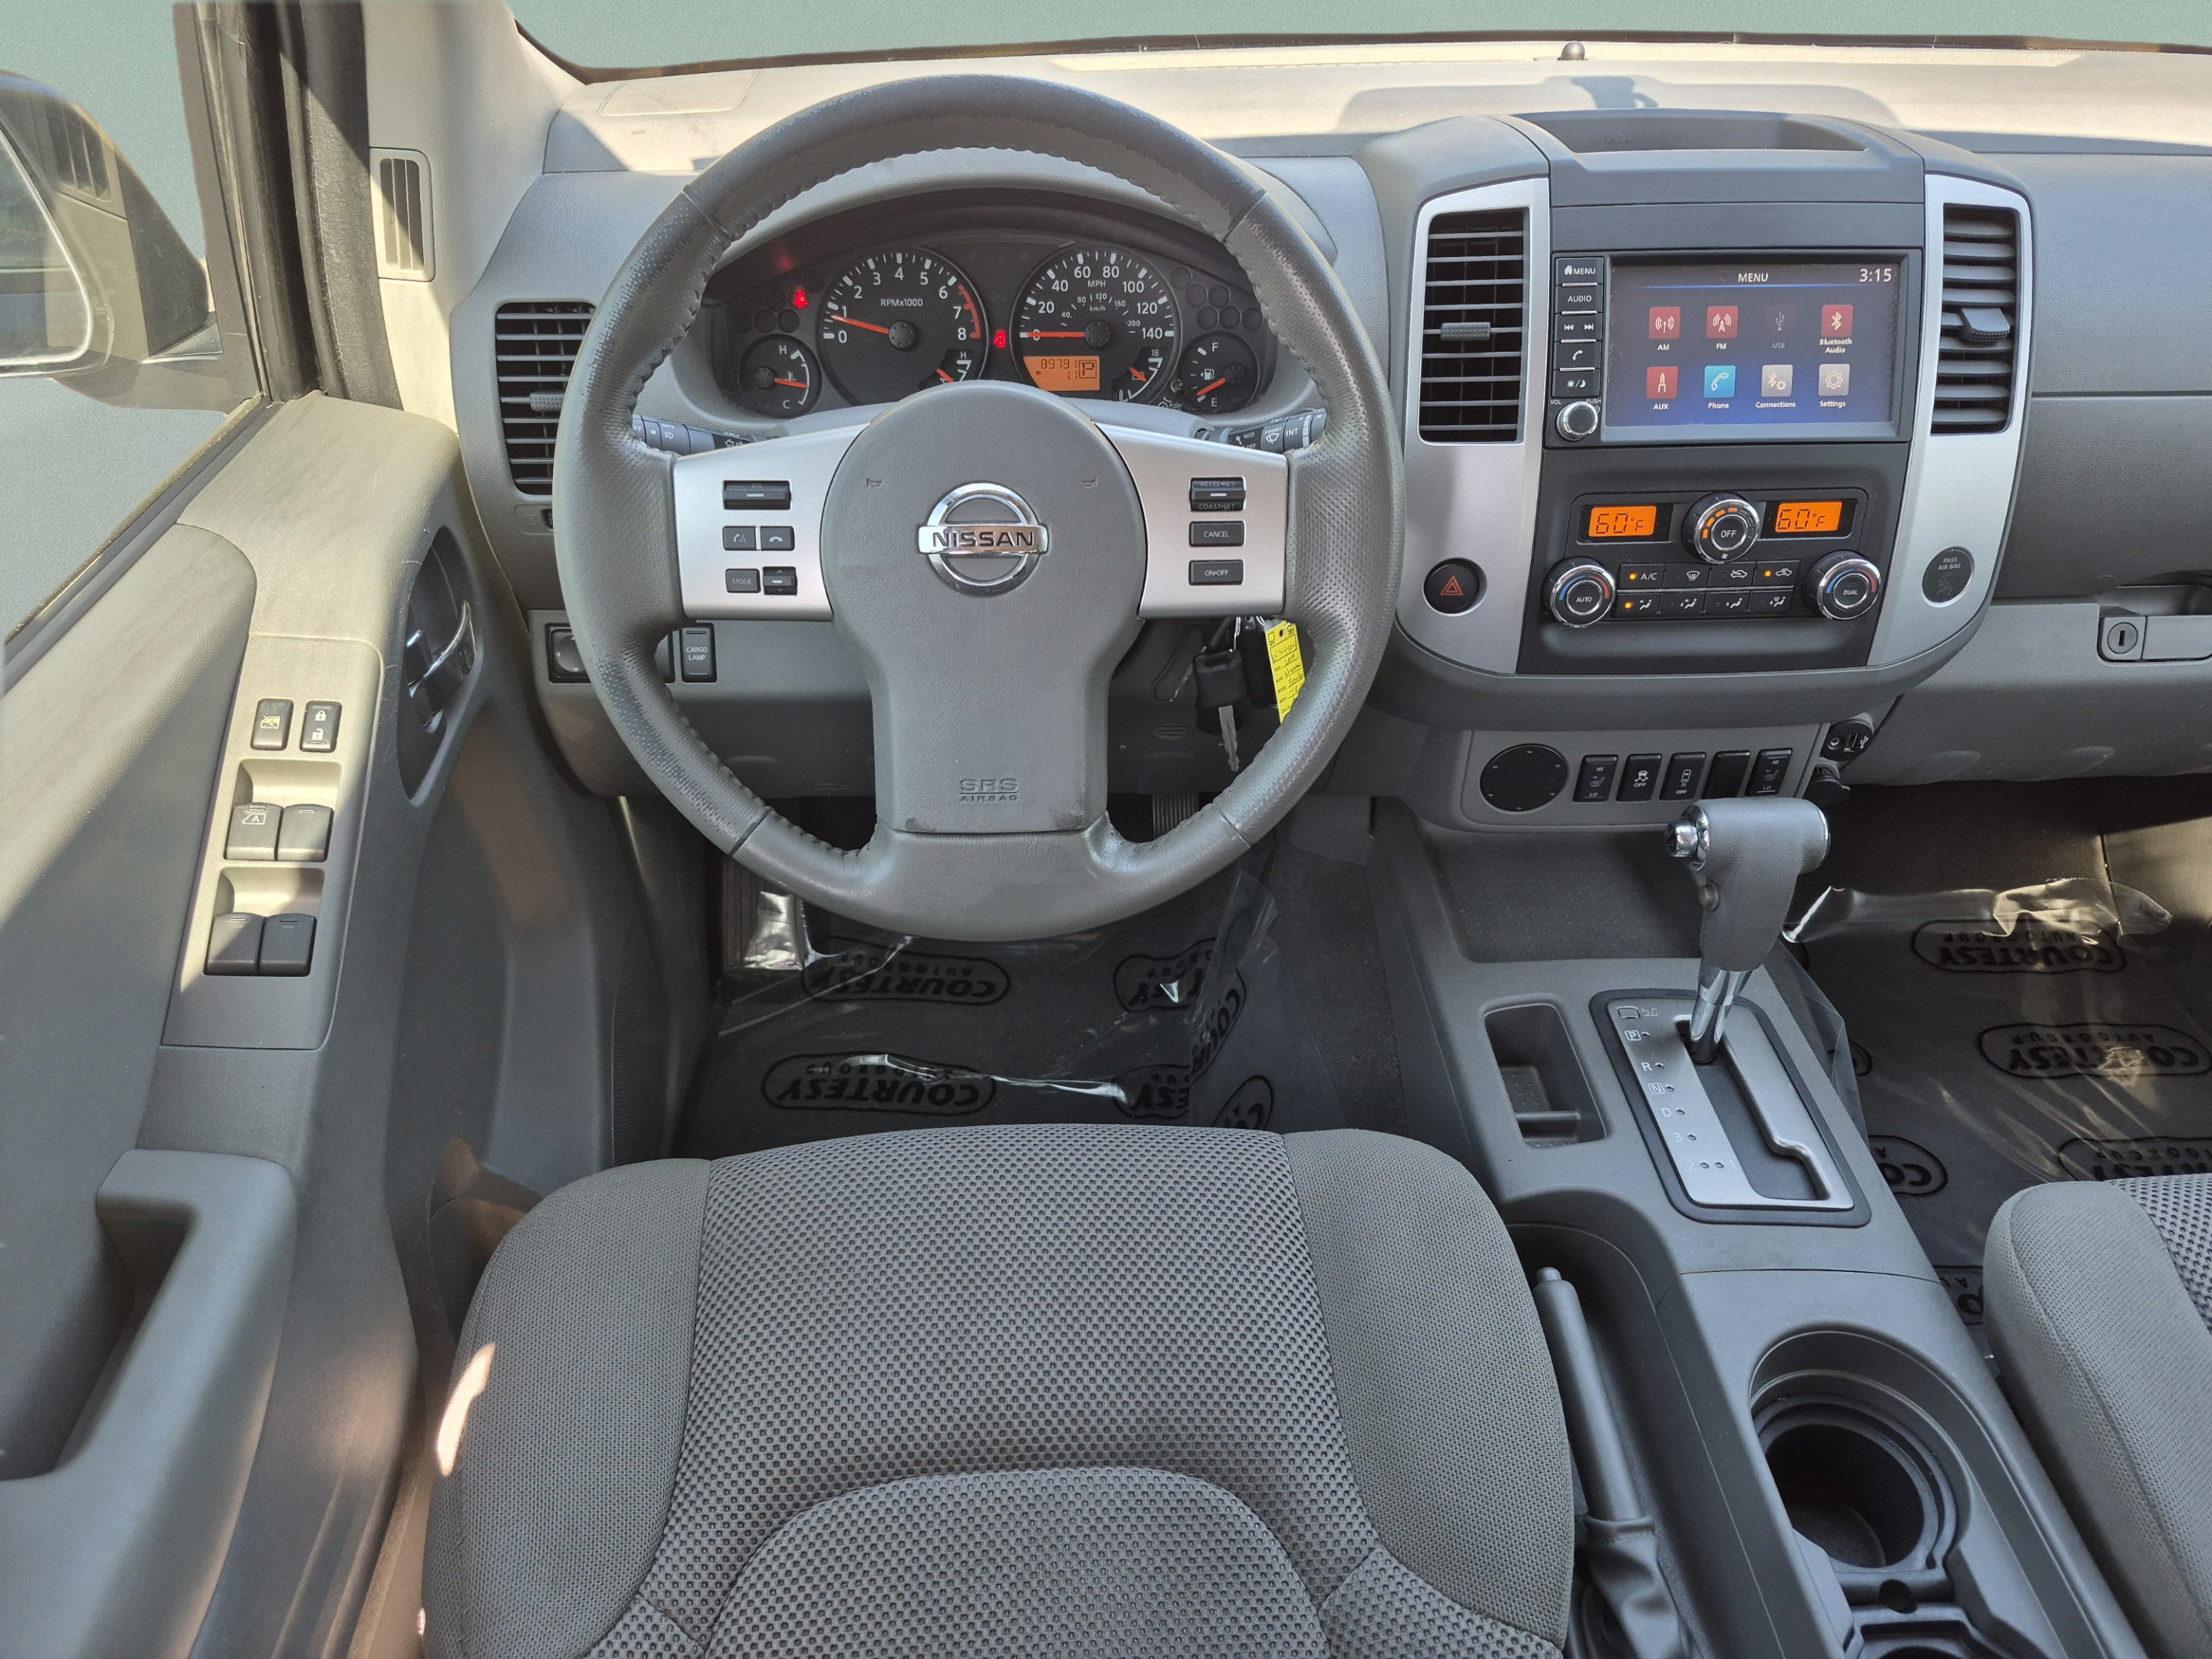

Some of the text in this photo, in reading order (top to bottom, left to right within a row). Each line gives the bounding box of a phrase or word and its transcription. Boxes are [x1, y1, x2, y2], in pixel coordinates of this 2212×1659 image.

[895, 268, 904, 280] 4
[1074, 267, 1091, 279] 60
[1102, 267, 1119, 279] 80
[1573, 267, 1596, 276] MENU
[1859, 268, 1892, 283] 3:15
[873, 273, 881, 285] 3
[920, 273, 929, 285] 5
[1737, 273, 1769, 283] MENU
[1051, 280, 1068, 292] 40
[1123, 281, 1144, 293] 100
[854, 286, 863, 299] 2
[939, 286, 948, 299] 6
[880, 298, 923, 307] RPMx1000
[1078, 296, 1087, 304] 80
[1568, 294, 1592, 303] AUDIO
[1038, 301, 1055, 313] 20
[1137, 303, 1157, 314] 120
[953, 306, 962, 319] 7
[838, 330, 848, 343] 0
[958, 328, 966, 341] 8
[1141, 328, 1163, 339] 140
[1820, 337, 1853, 346] Bluetooth
[779, 345, 787, 355] H
[1211, 343, 1218, 353] F
[1657, 343, 1670, 351] AM
[1825, 346, 1846, 354] Audio
[783, 399, 790, 409] C
[1211, 398, 1218, 407] E
[1755, 400, 1796, 409] Connections
[1820, 400, 1846, 409] Settings
[1286, 428, 1299, 436] INT
[1720, 529, 1737, 538] OFF
[932, 531, 1035, 547] NISSAN
[1641, 572, 1657, 582] A/C
[960, 777, 1019, 792] SRS
[1641, 1062, 1653, 1071] R
[777, 1077, 980, 1106] COURTESY
[1661, 1108, 1672, 1117] D
[1673, 1132, 1683, 1142] 3
